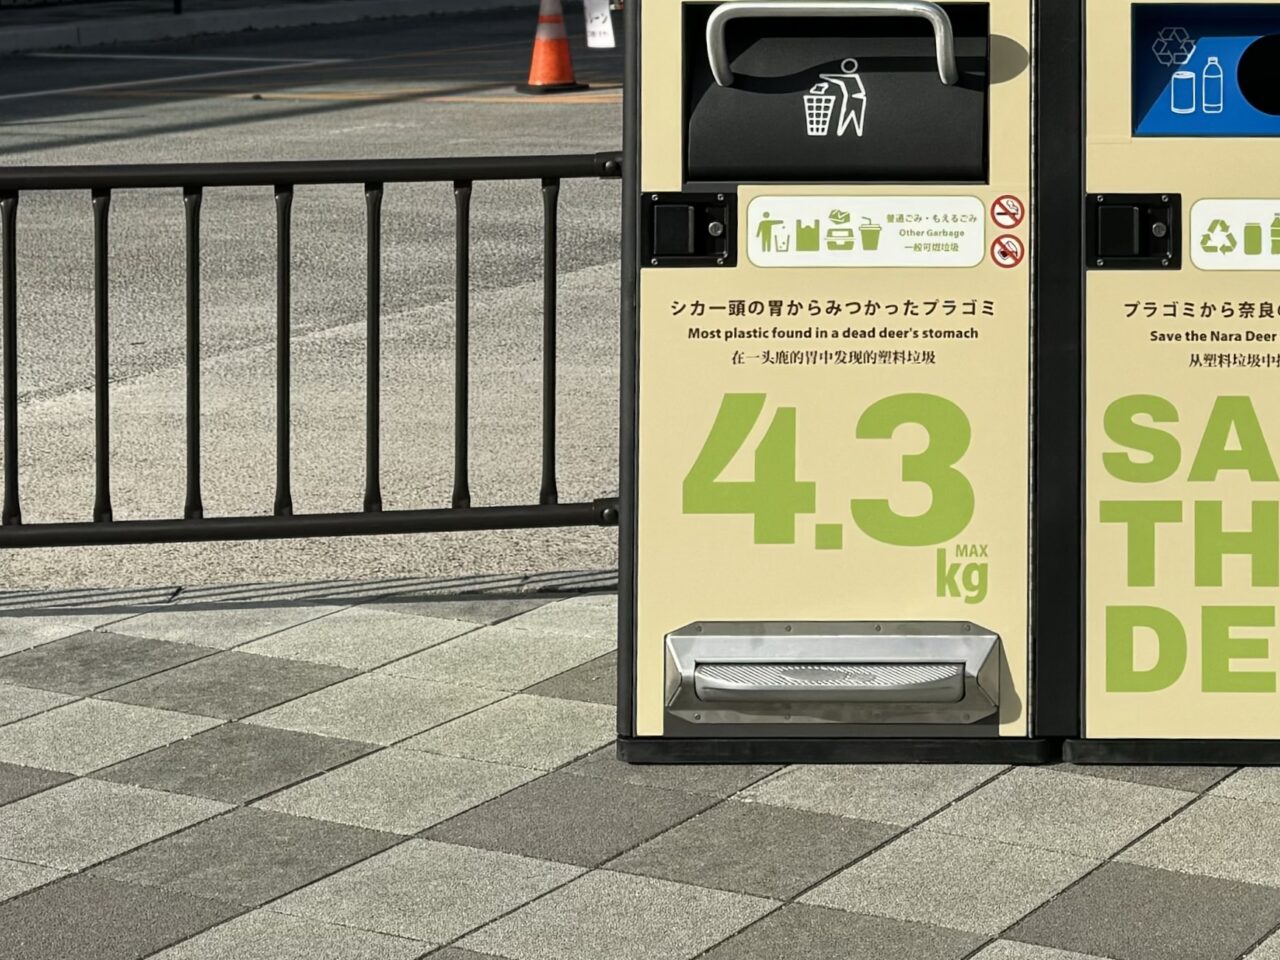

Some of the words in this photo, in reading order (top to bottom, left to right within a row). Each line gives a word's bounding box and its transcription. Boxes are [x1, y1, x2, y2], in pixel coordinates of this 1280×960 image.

[899, 228, 925, 237] Other
[926, 228, 965, 239] Garbage
[670, 299, 995, 317] シカ一頭の胃からみつかったプラゴミ
[687, 327, 722, 339] Most
[724, 327, 770, 342] plastic
[771, 327, 813, 339] found
[815, 327, 829, 339] in
[830, 330, 840, 339] a
[841, 327, 876, 339] dead
[878, 327, 920, 339] deer's
[921, 327, 979, 339] stomach
[1149, 330, 1183, 342] Save
[1184, 330, 1208, 342] the
[1210, 330, 1243, 342] Nara
[1245, 330, 1278, 342] Deer
[730, 349, 937, 366] 在一头鹿的胃中发现的塑料垃圾
[682, 392, 976, 550] 4.3
[955, 543, 989, 558] MAX
[936, 547, 989, 605] kg
